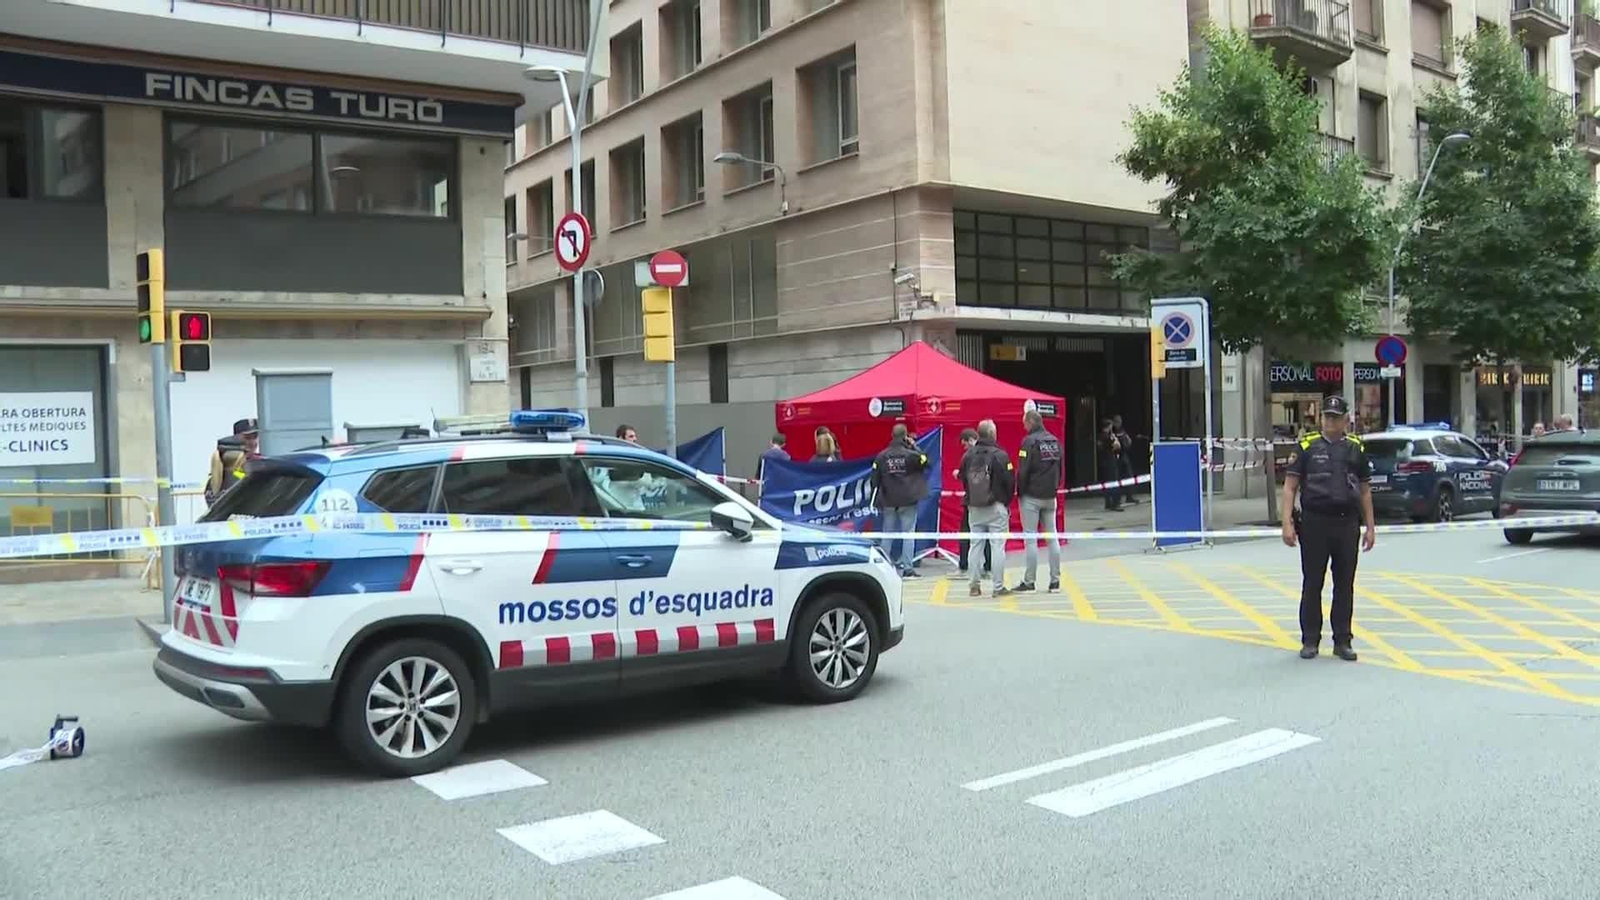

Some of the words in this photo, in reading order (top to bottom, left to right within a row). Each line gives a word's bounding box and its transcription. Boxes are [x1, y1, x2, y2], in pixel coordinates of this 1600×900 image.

[145, 73, 314, 111] FINCAS
[330, 91, 443, 123] TURÓ
[1270, 365, 1314, 381] ERSONAL
[1315, 366, 1341, 381] FOTO
[1354, 368, 1386, 379] PERSON
[0, 409, 19, 418] RA
[22, 407, 86, 418] OBERTURA
[0, 423, 27, 432] LTES
[0, 439, 69, 452] -CLINICS
[1459, 480, 1492, 491] NACIONAL
[793, 478, 872, 516] POLI
[322, 498, 350, 512] 112
[499, 597, 618, 625] mossos
[628, 584, 774, 617] d'esquadra
